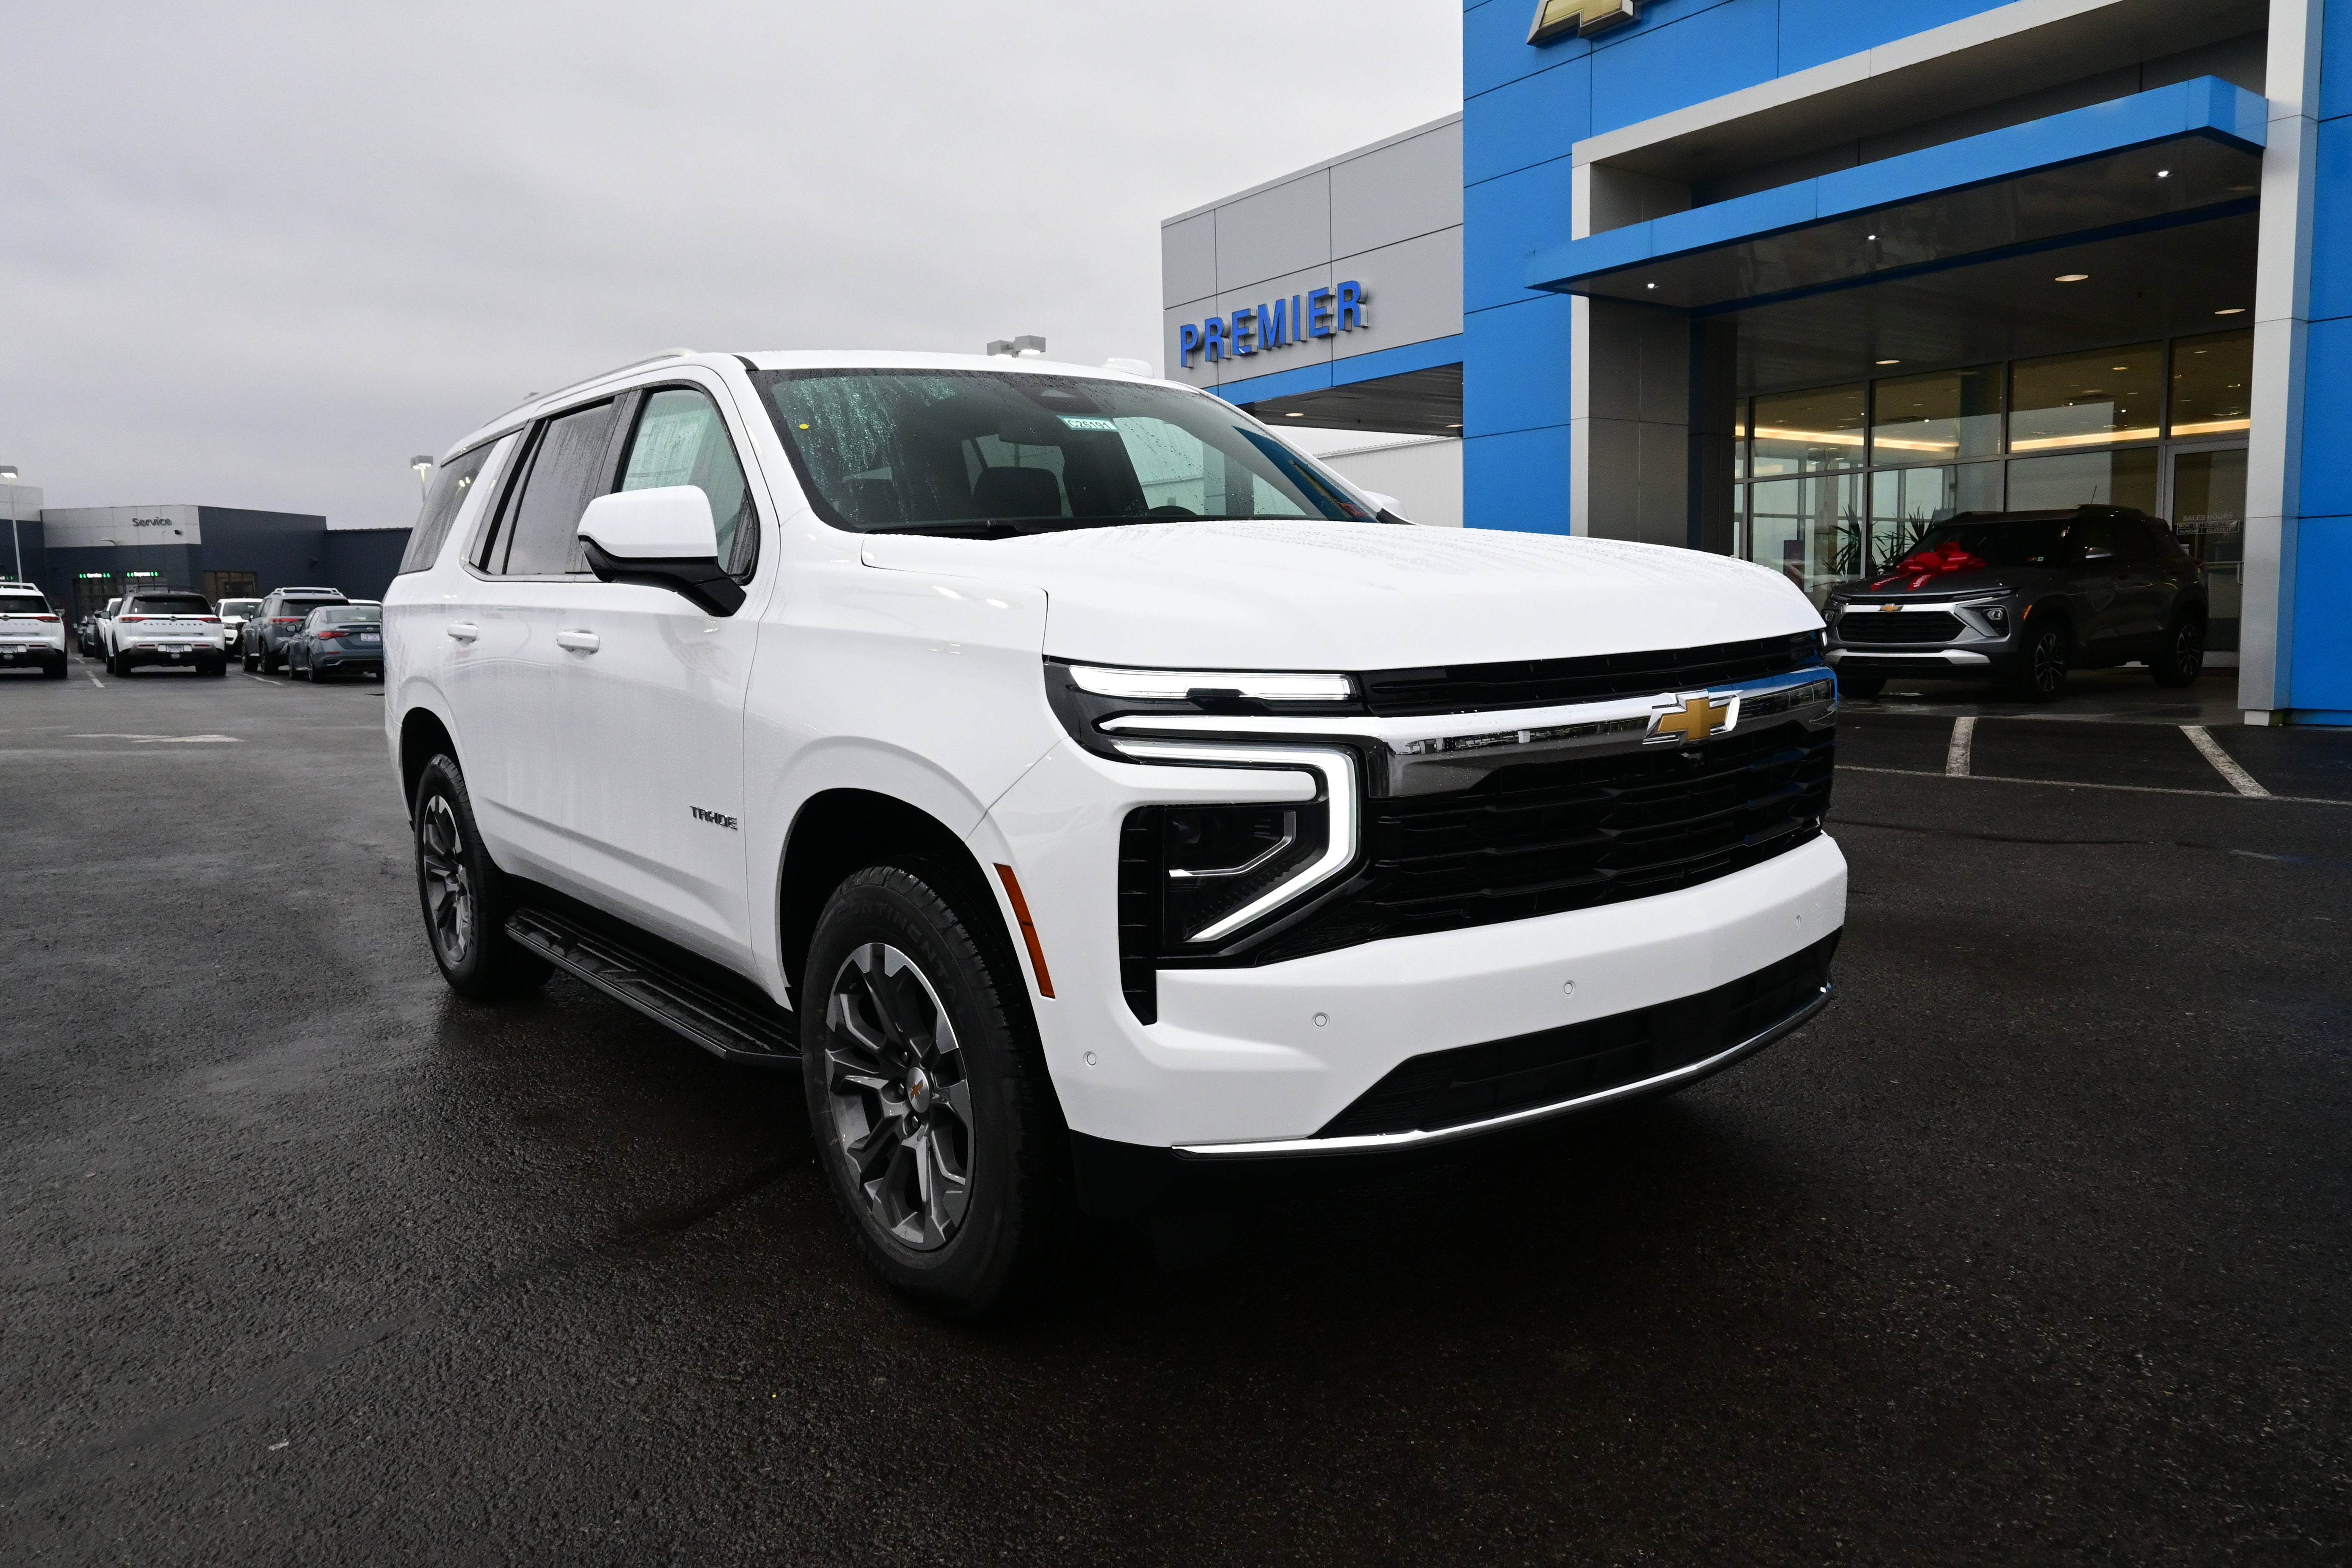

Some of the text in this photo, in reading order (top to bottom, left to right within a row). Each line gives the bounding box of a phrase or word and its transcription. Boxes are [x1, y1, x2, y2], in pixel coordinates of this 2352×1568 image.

[1180, 280, 1369, 368] PREMIER
[1067, 420, 1112, 429] C26191
[132, 516, 172, 527] Service
[689, 806, 738, 830] TAHOE
